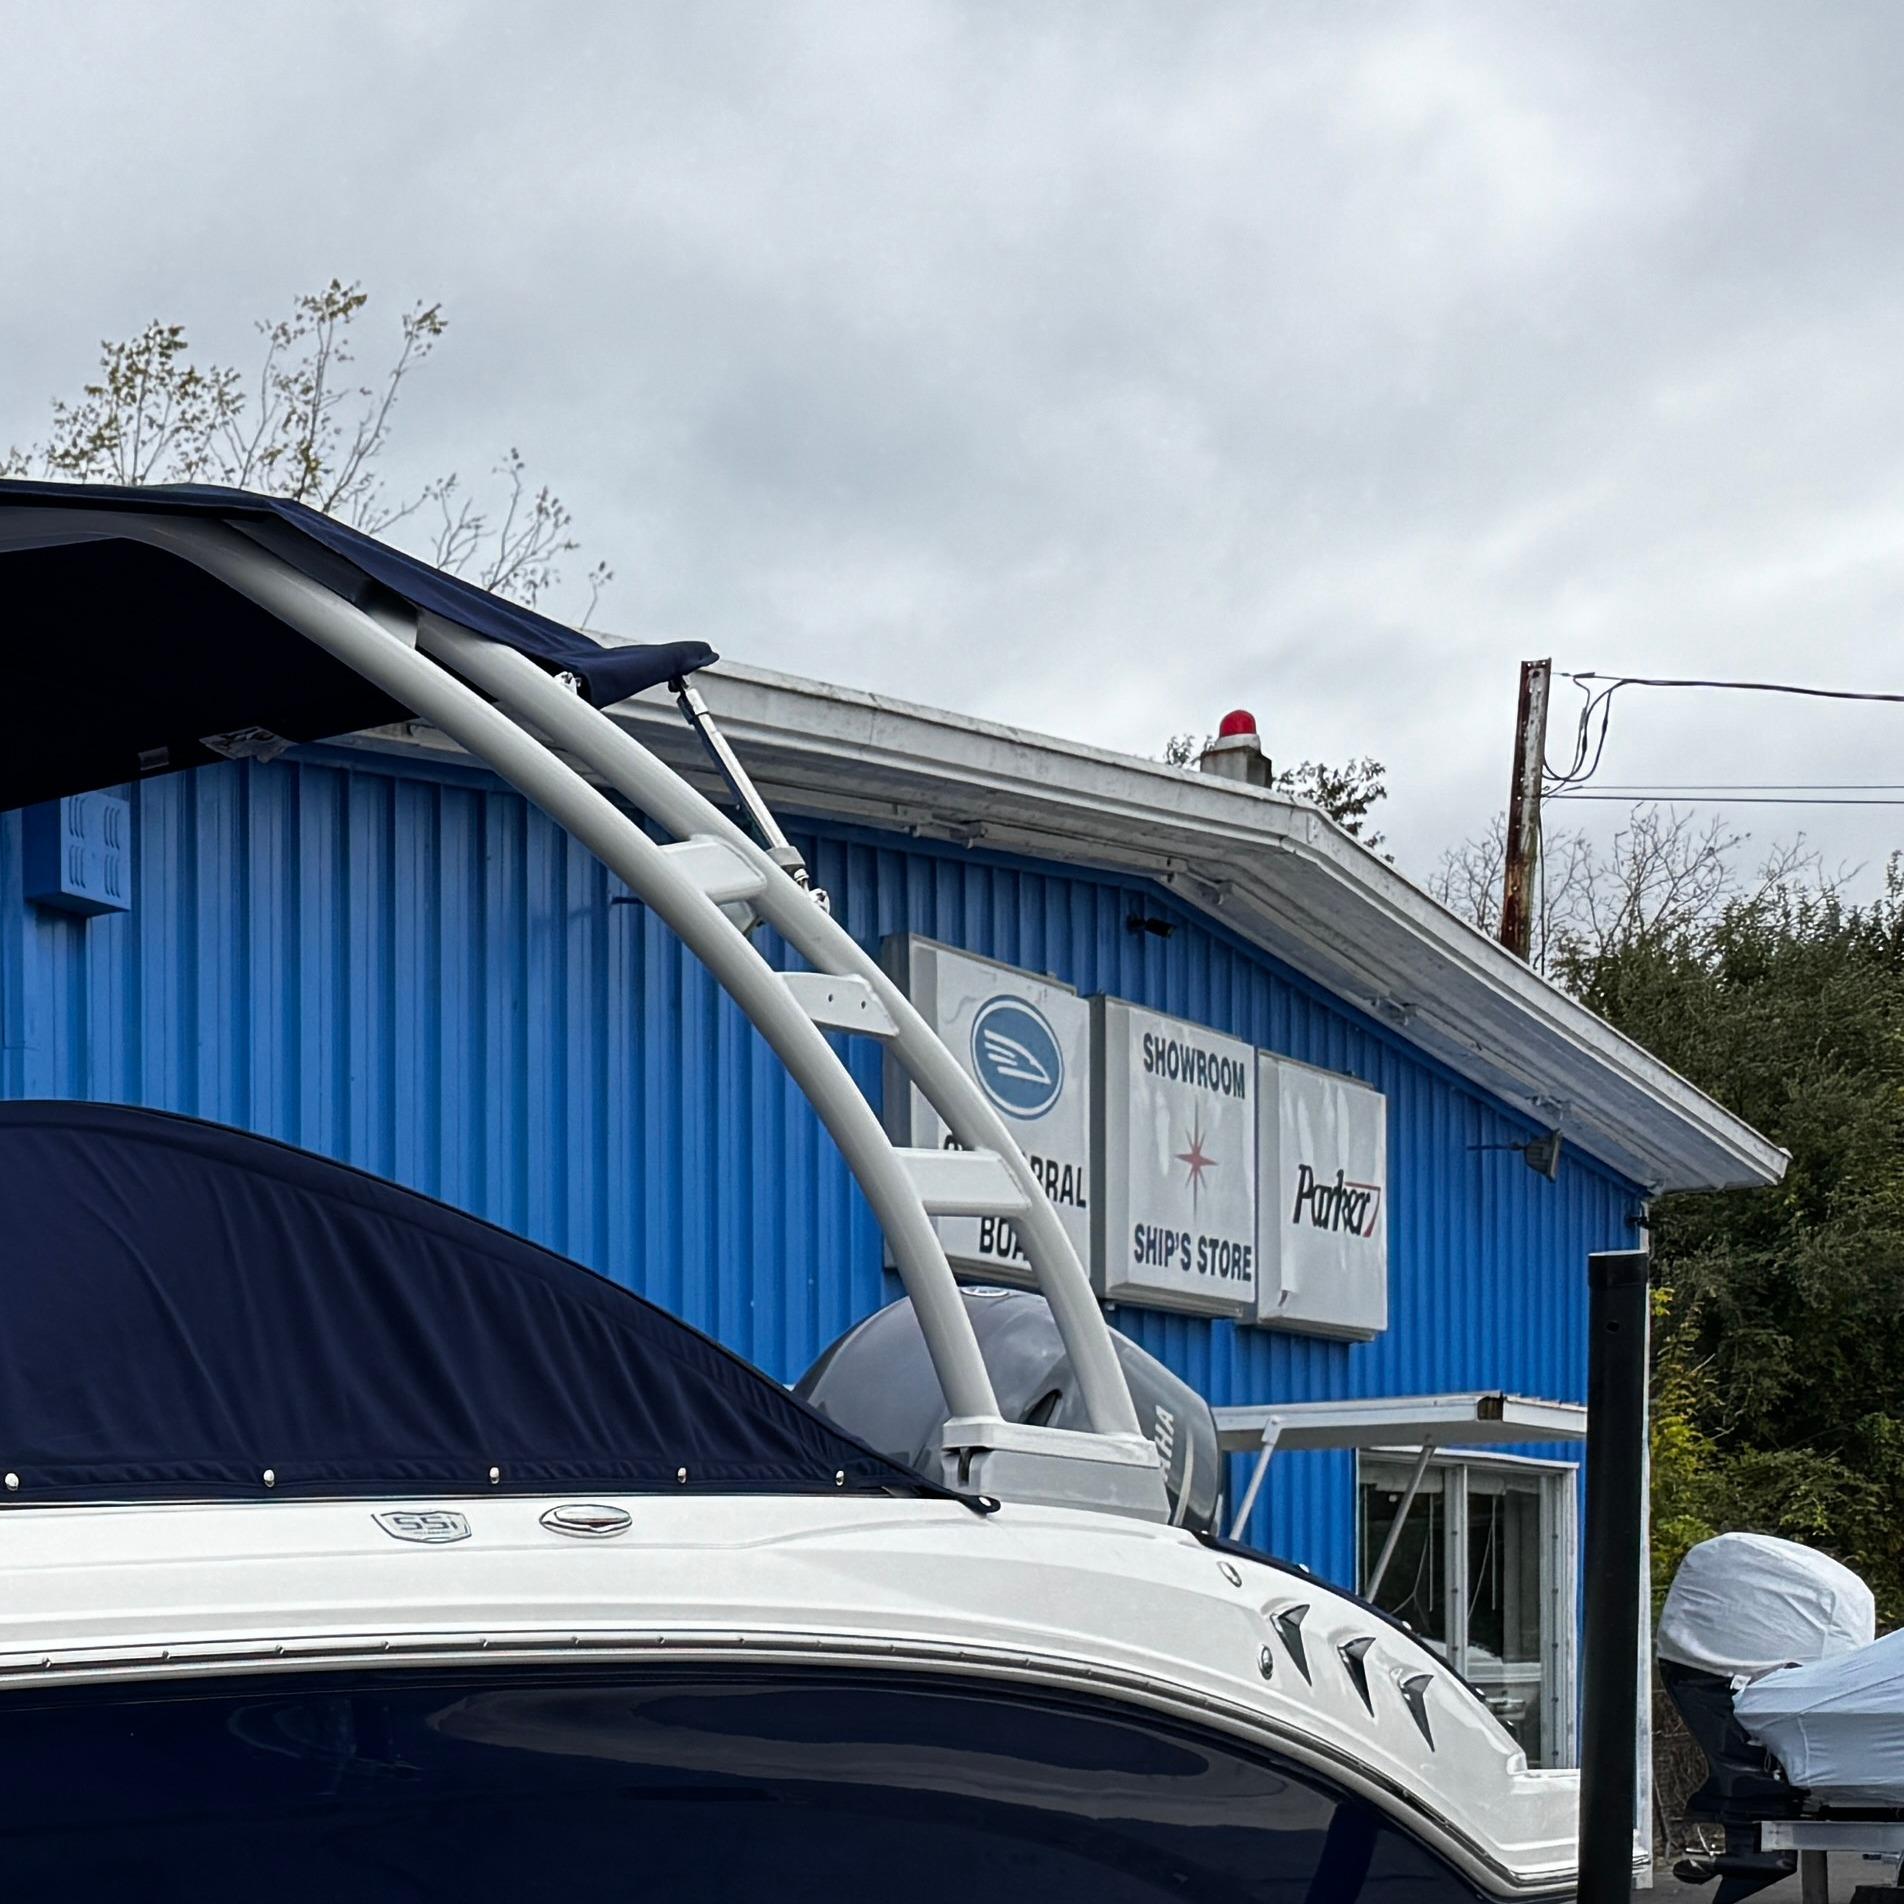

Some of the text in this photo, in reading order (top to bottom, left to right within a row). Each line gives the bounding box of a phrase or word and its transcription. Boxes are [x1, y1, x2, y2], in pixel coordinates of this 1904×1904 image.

[1143, 1031, 1247, 1101] SHOWROOM
[1292, 1163, 1372, 1236] Parker
[1132, 1222, 1253, 1284] SHIP'S STORE
